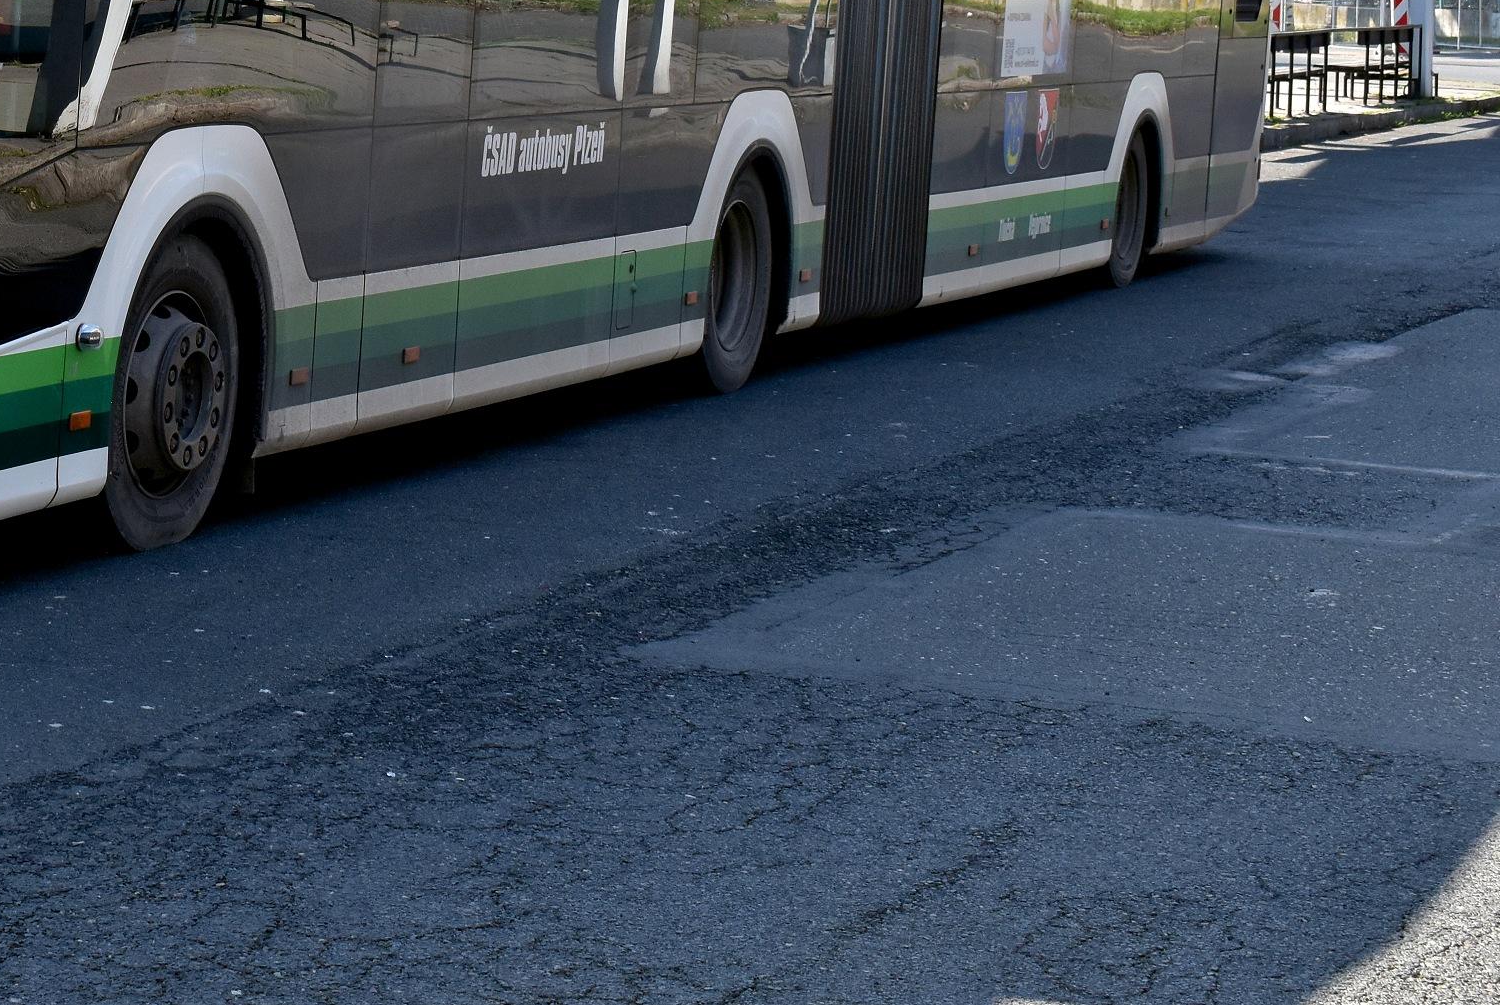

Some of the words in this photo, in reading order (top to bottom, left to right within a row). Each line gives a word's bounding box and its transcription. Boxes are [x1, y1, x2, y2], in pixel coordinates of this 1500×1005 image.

[481, 125, 517, 177] ČSAD
[517, 128, 573, 175] autobusy
[572, 121, 606, 166] Plzeň
